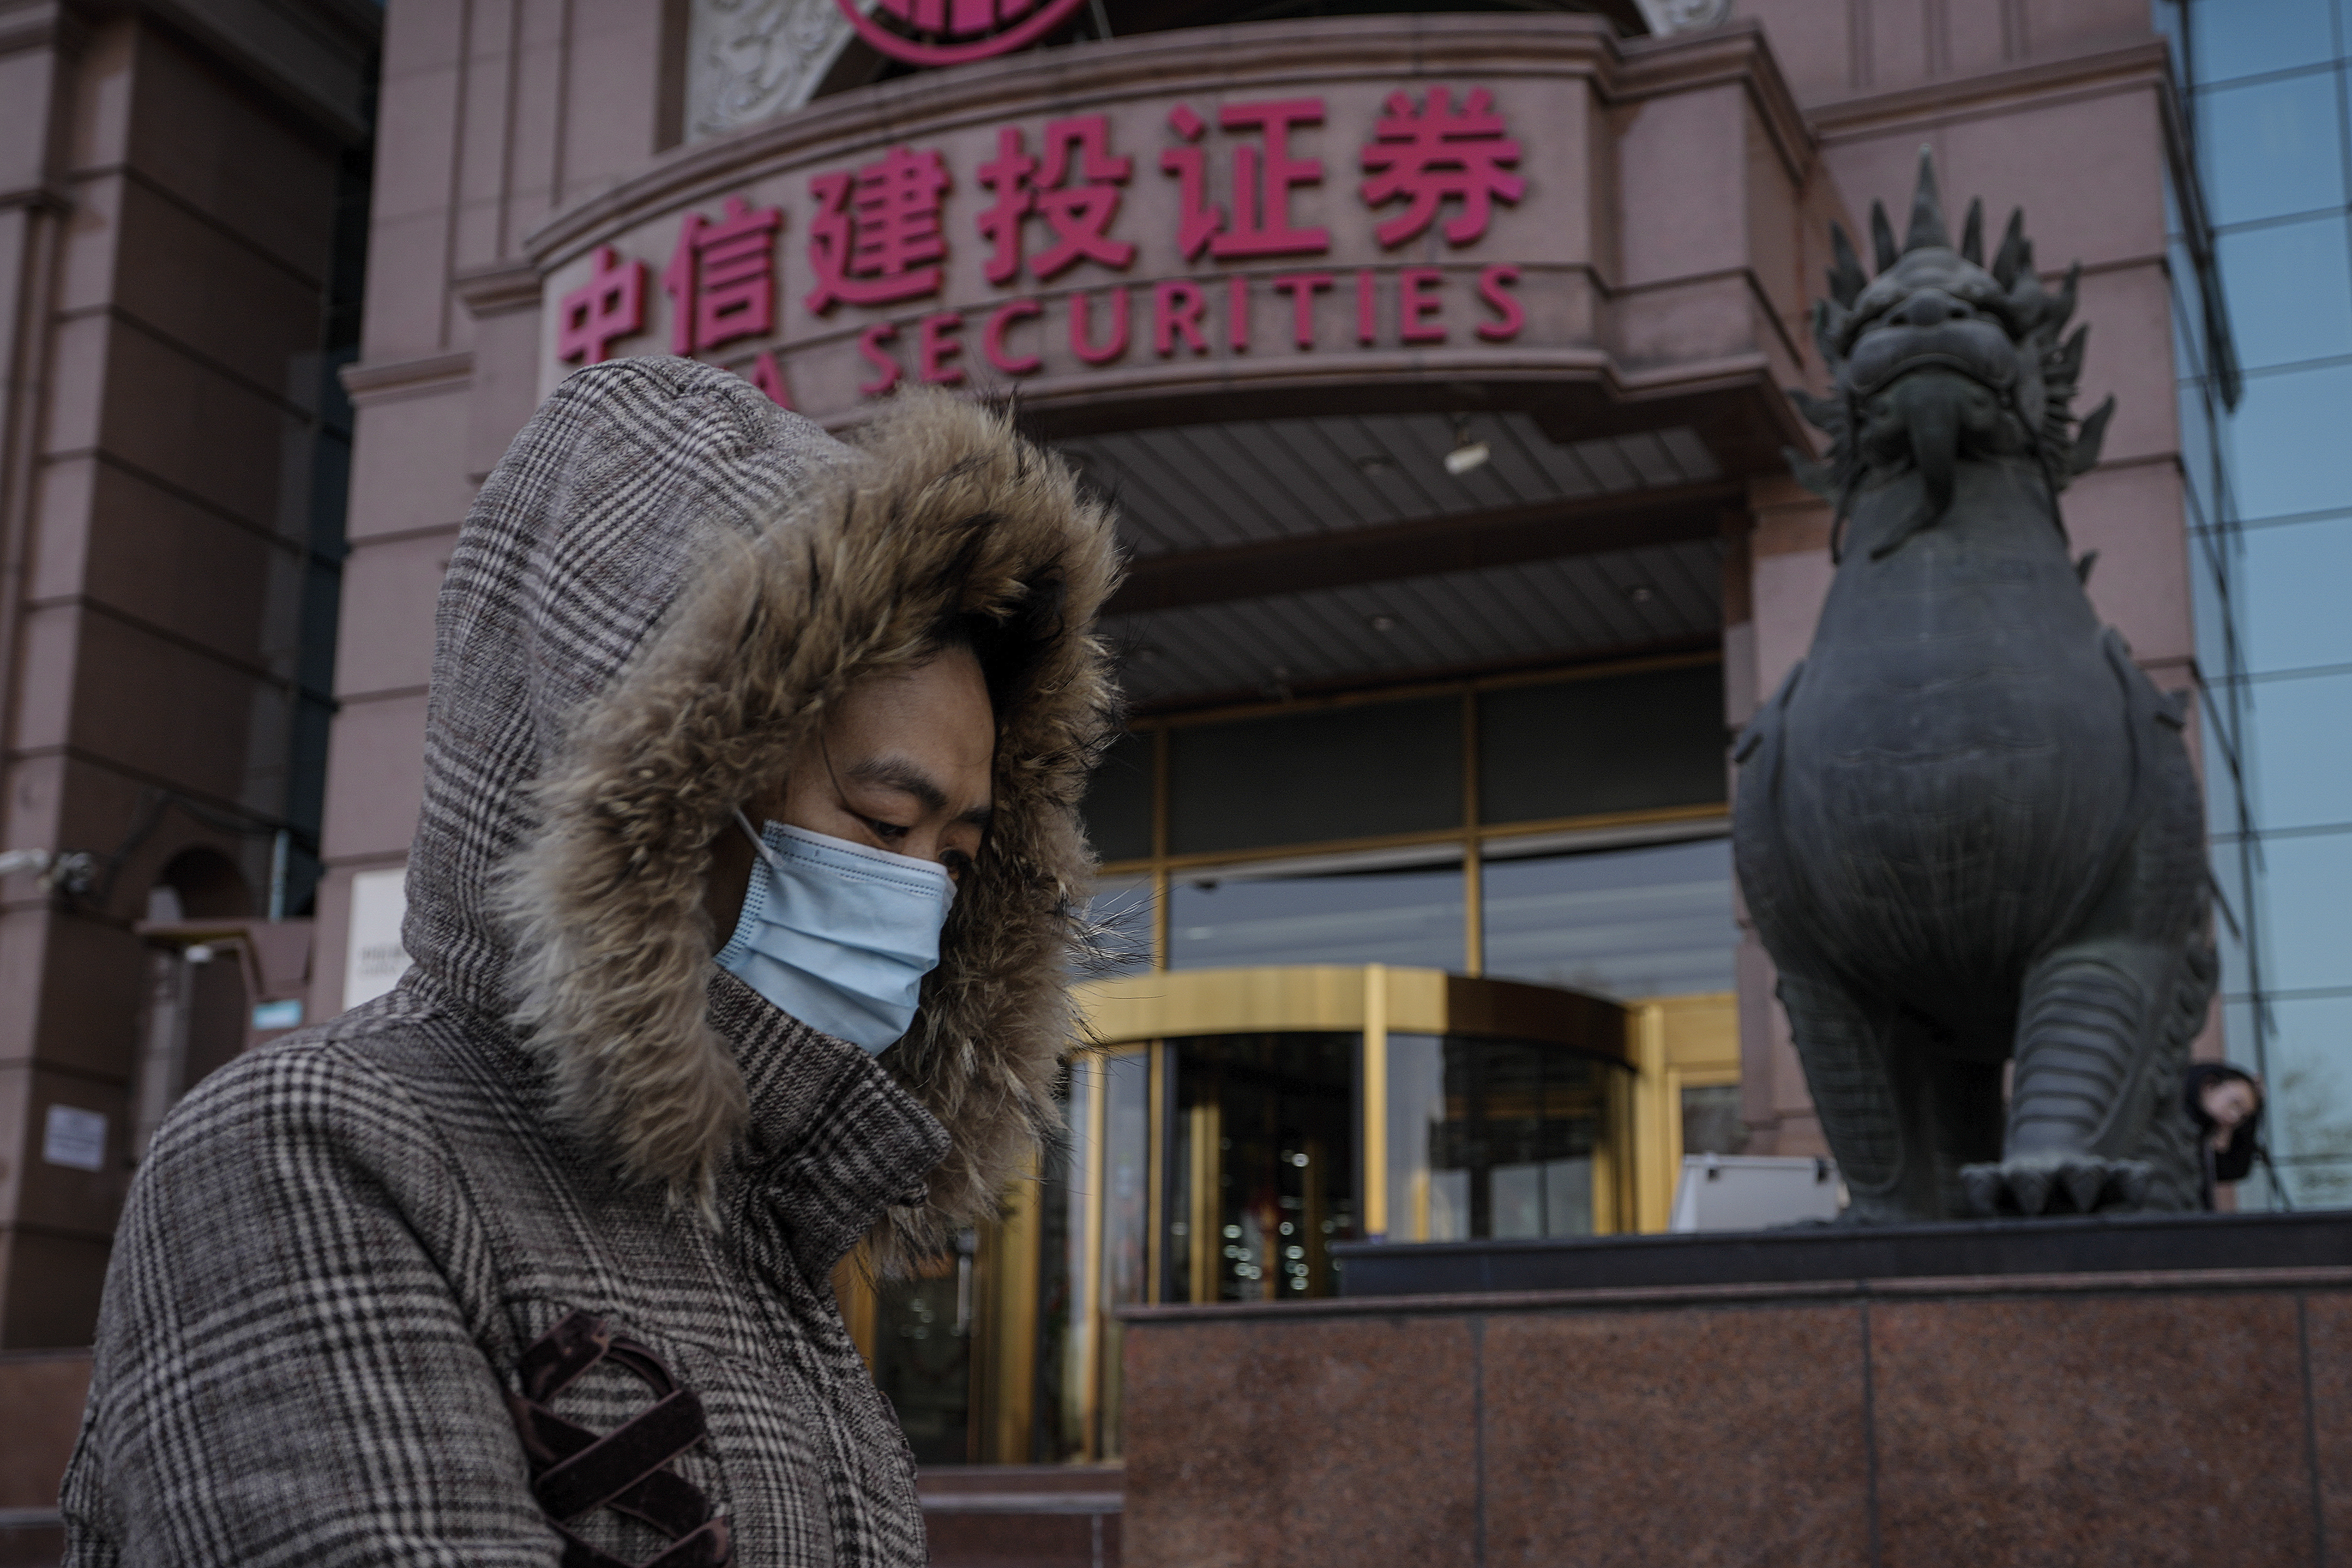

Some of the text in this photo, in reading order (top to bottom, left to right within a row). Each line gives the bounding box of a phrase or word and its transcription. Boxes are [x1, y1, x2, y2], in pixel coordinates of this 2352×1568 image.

[557, 85, 1527, 365] 中信建投证券
[858, 264, 1526, 393] SECURITIES
